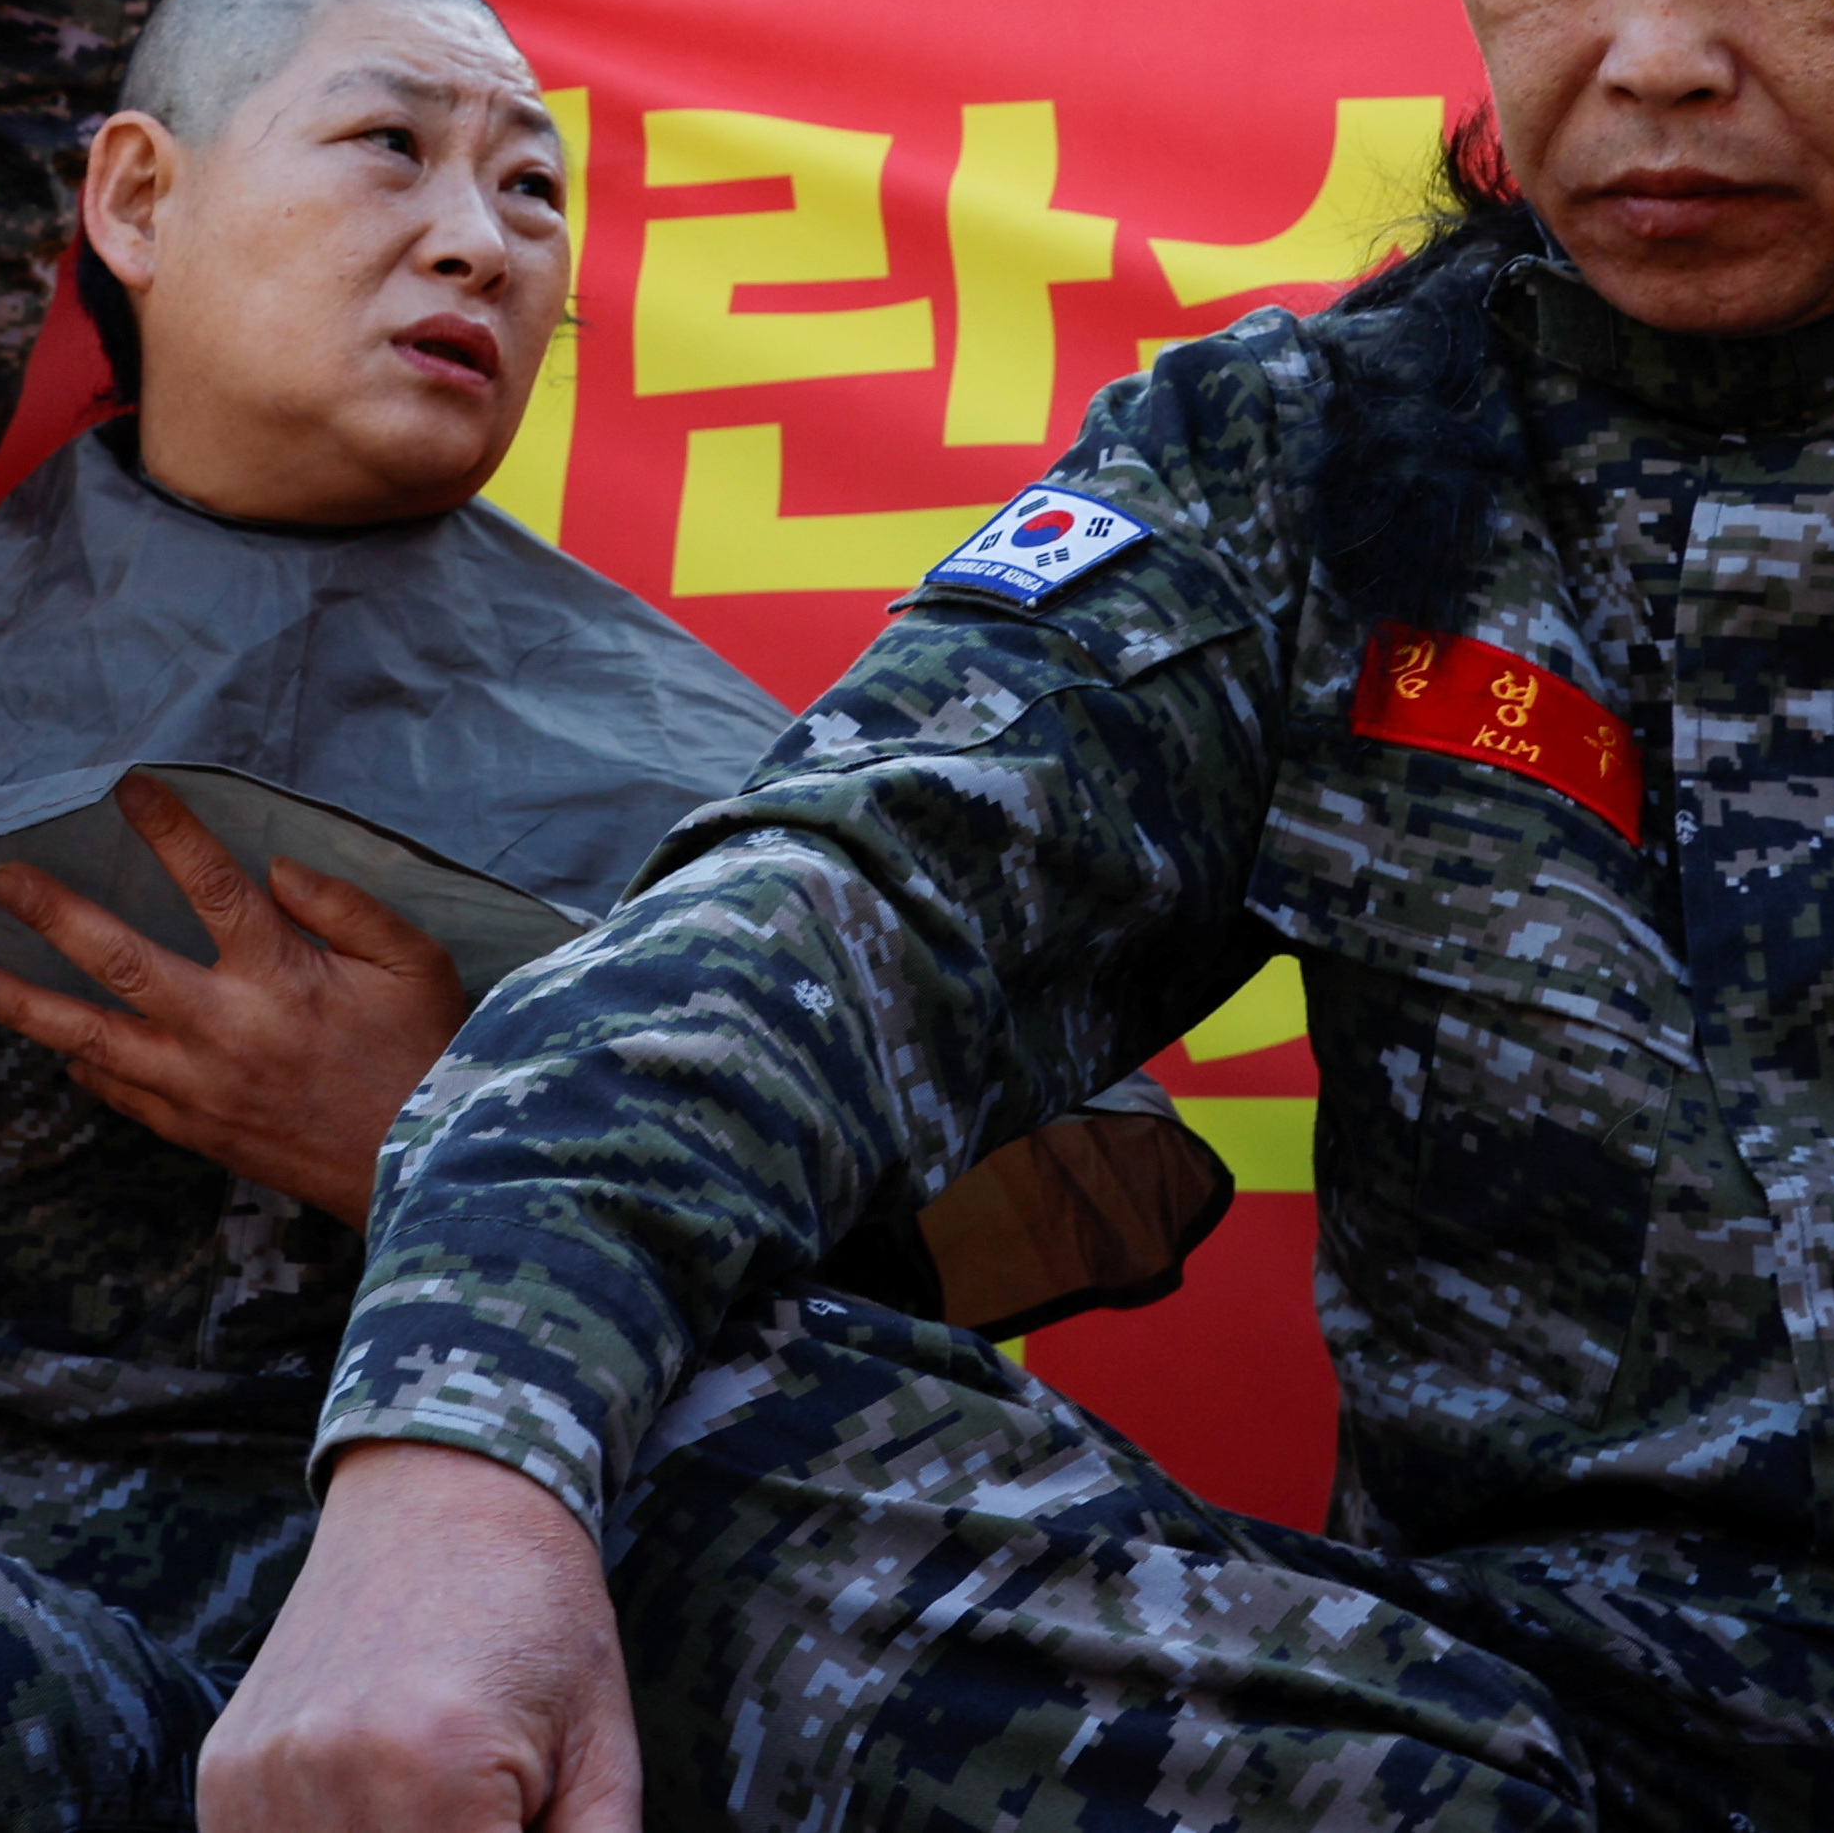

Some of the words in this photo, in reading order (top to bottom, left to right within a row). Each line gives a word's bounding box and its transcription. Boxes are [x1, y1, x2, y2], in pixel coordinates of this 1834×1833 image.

[938, 559, 989, 576] REPUBLIC
[983, 563, 1002, 577] OF
[999, 568, 1045, 592] KOREA
[1471, 724, 1543, 763] KIM
